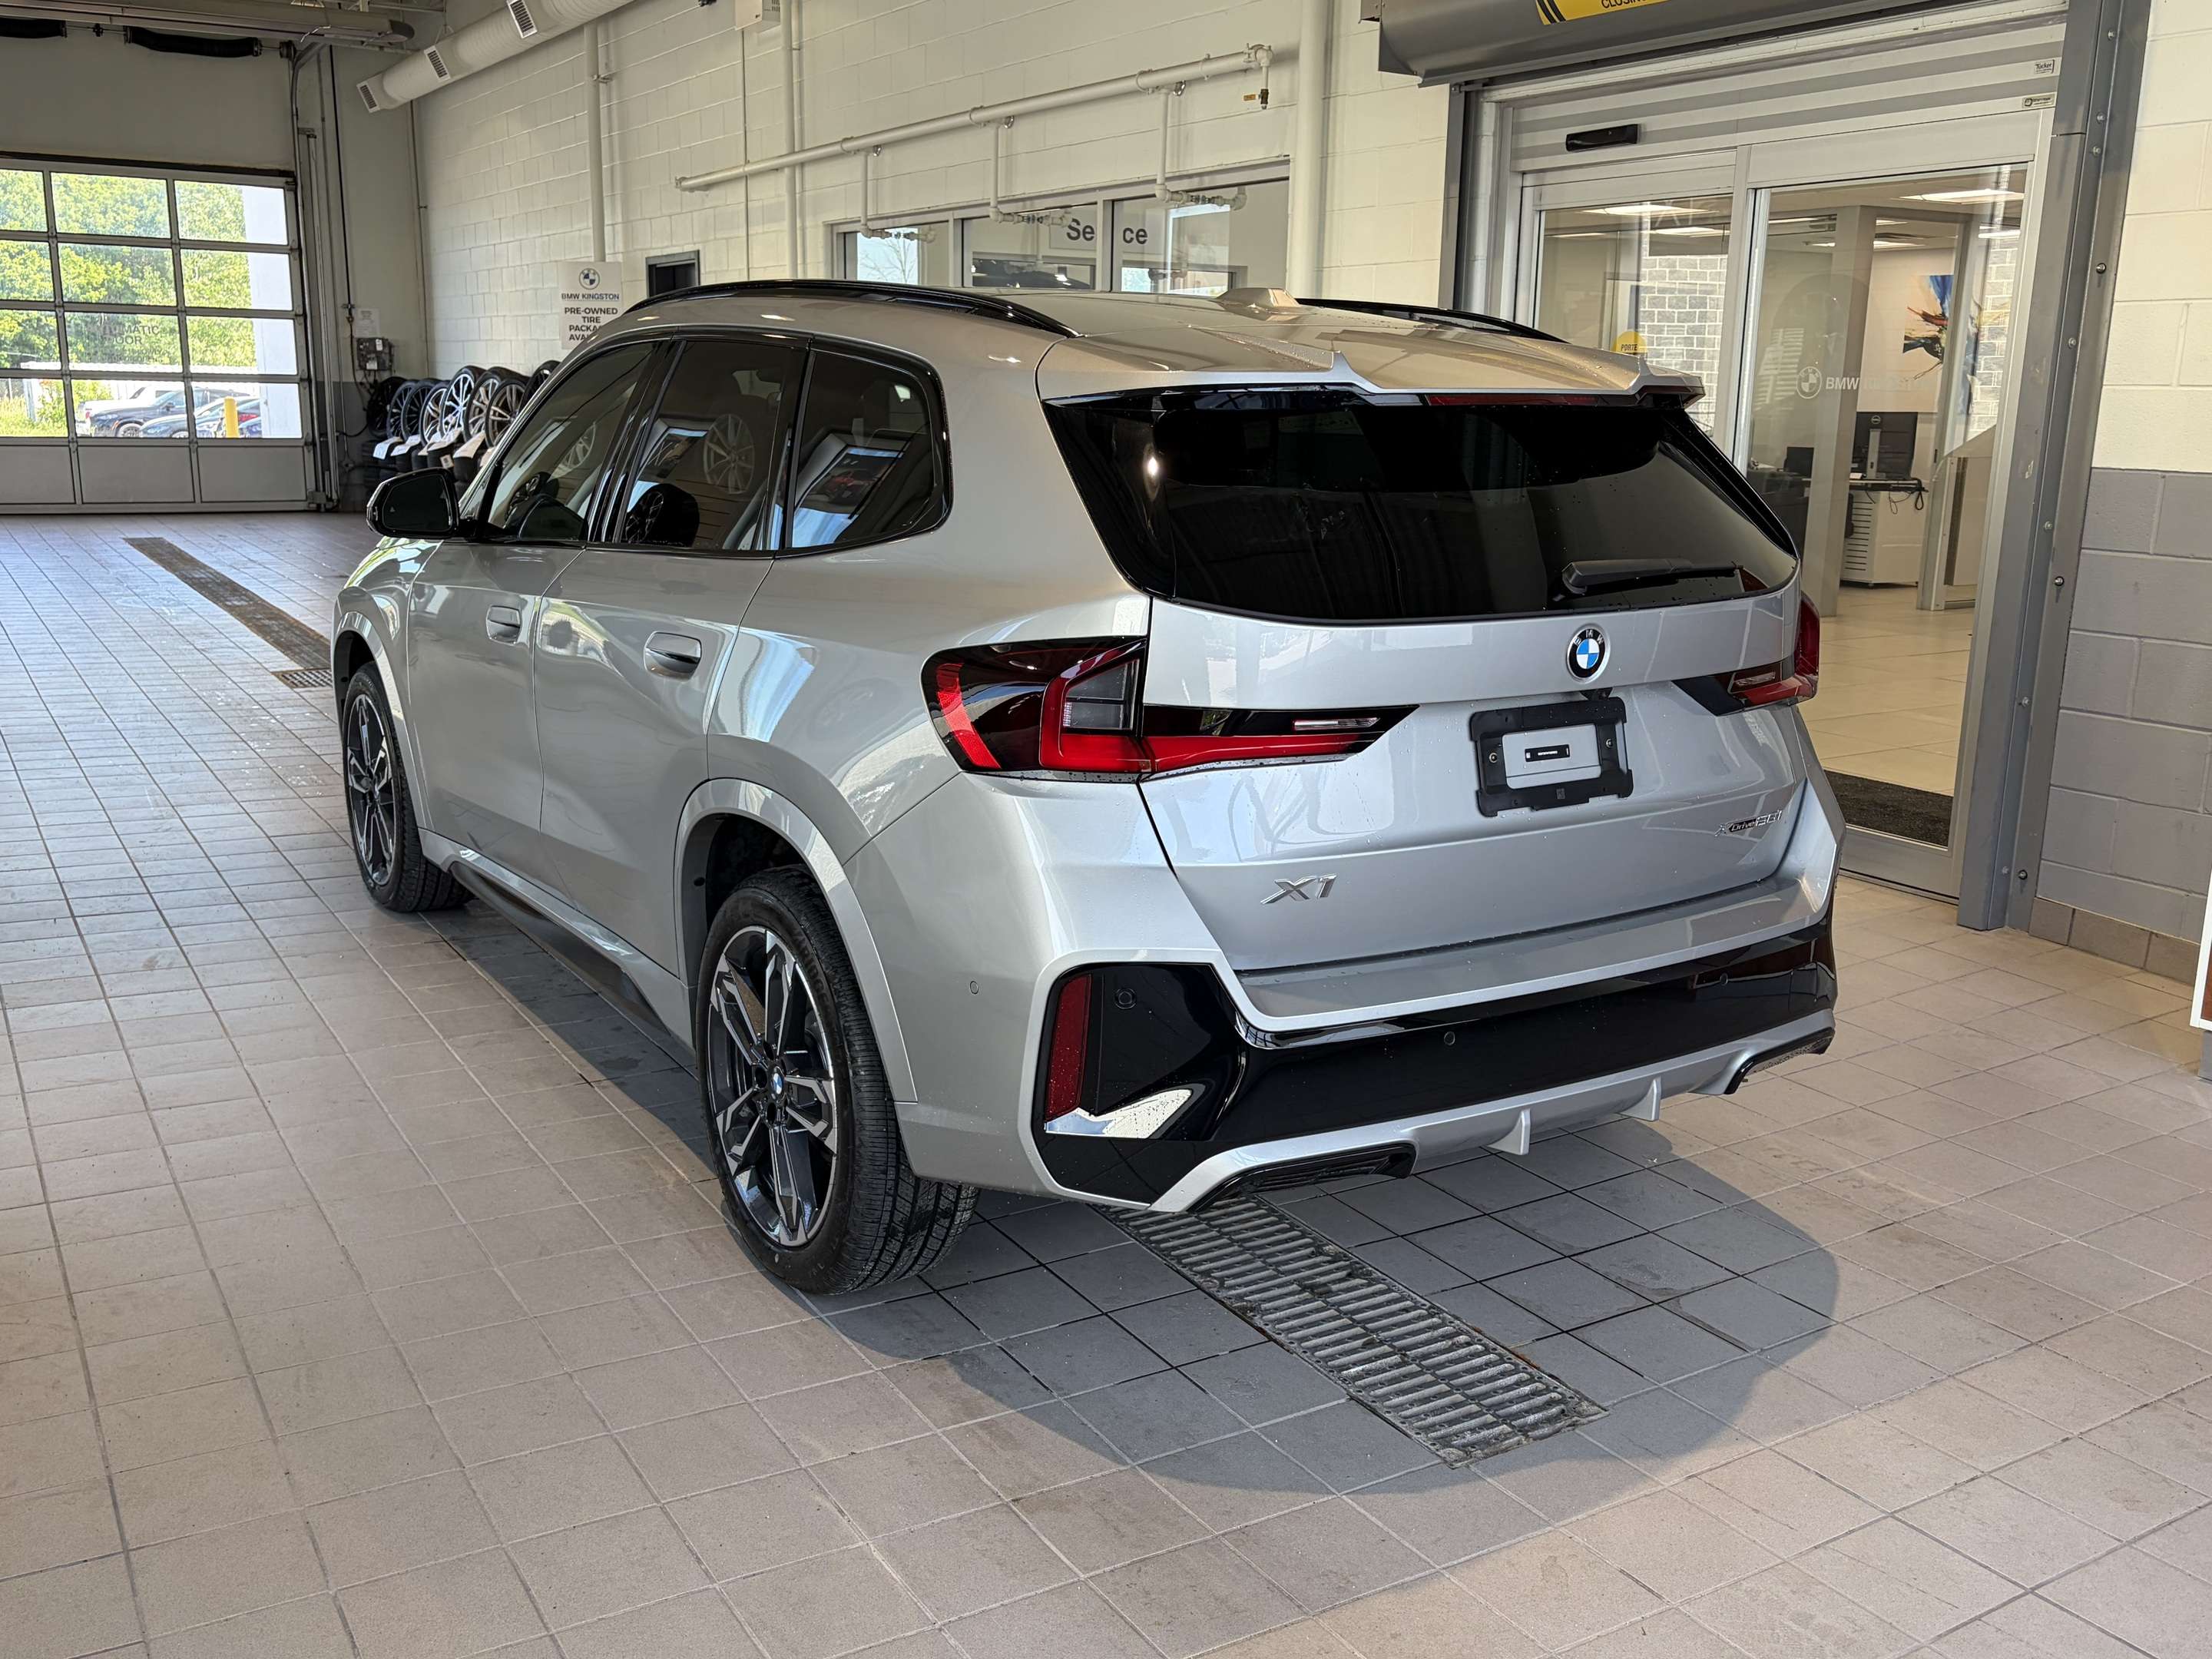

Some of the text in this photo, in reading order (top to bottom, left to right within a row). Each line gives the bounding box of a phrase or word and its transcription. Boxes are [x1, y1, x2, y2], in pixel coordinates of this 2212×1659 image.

[1066, 217, 1148, 244] Sece
[1621, 343, 1638, 352] PORTE
[1825, 376, 1859, 390] BMW
[1260, 873, 1338, 905] X1
